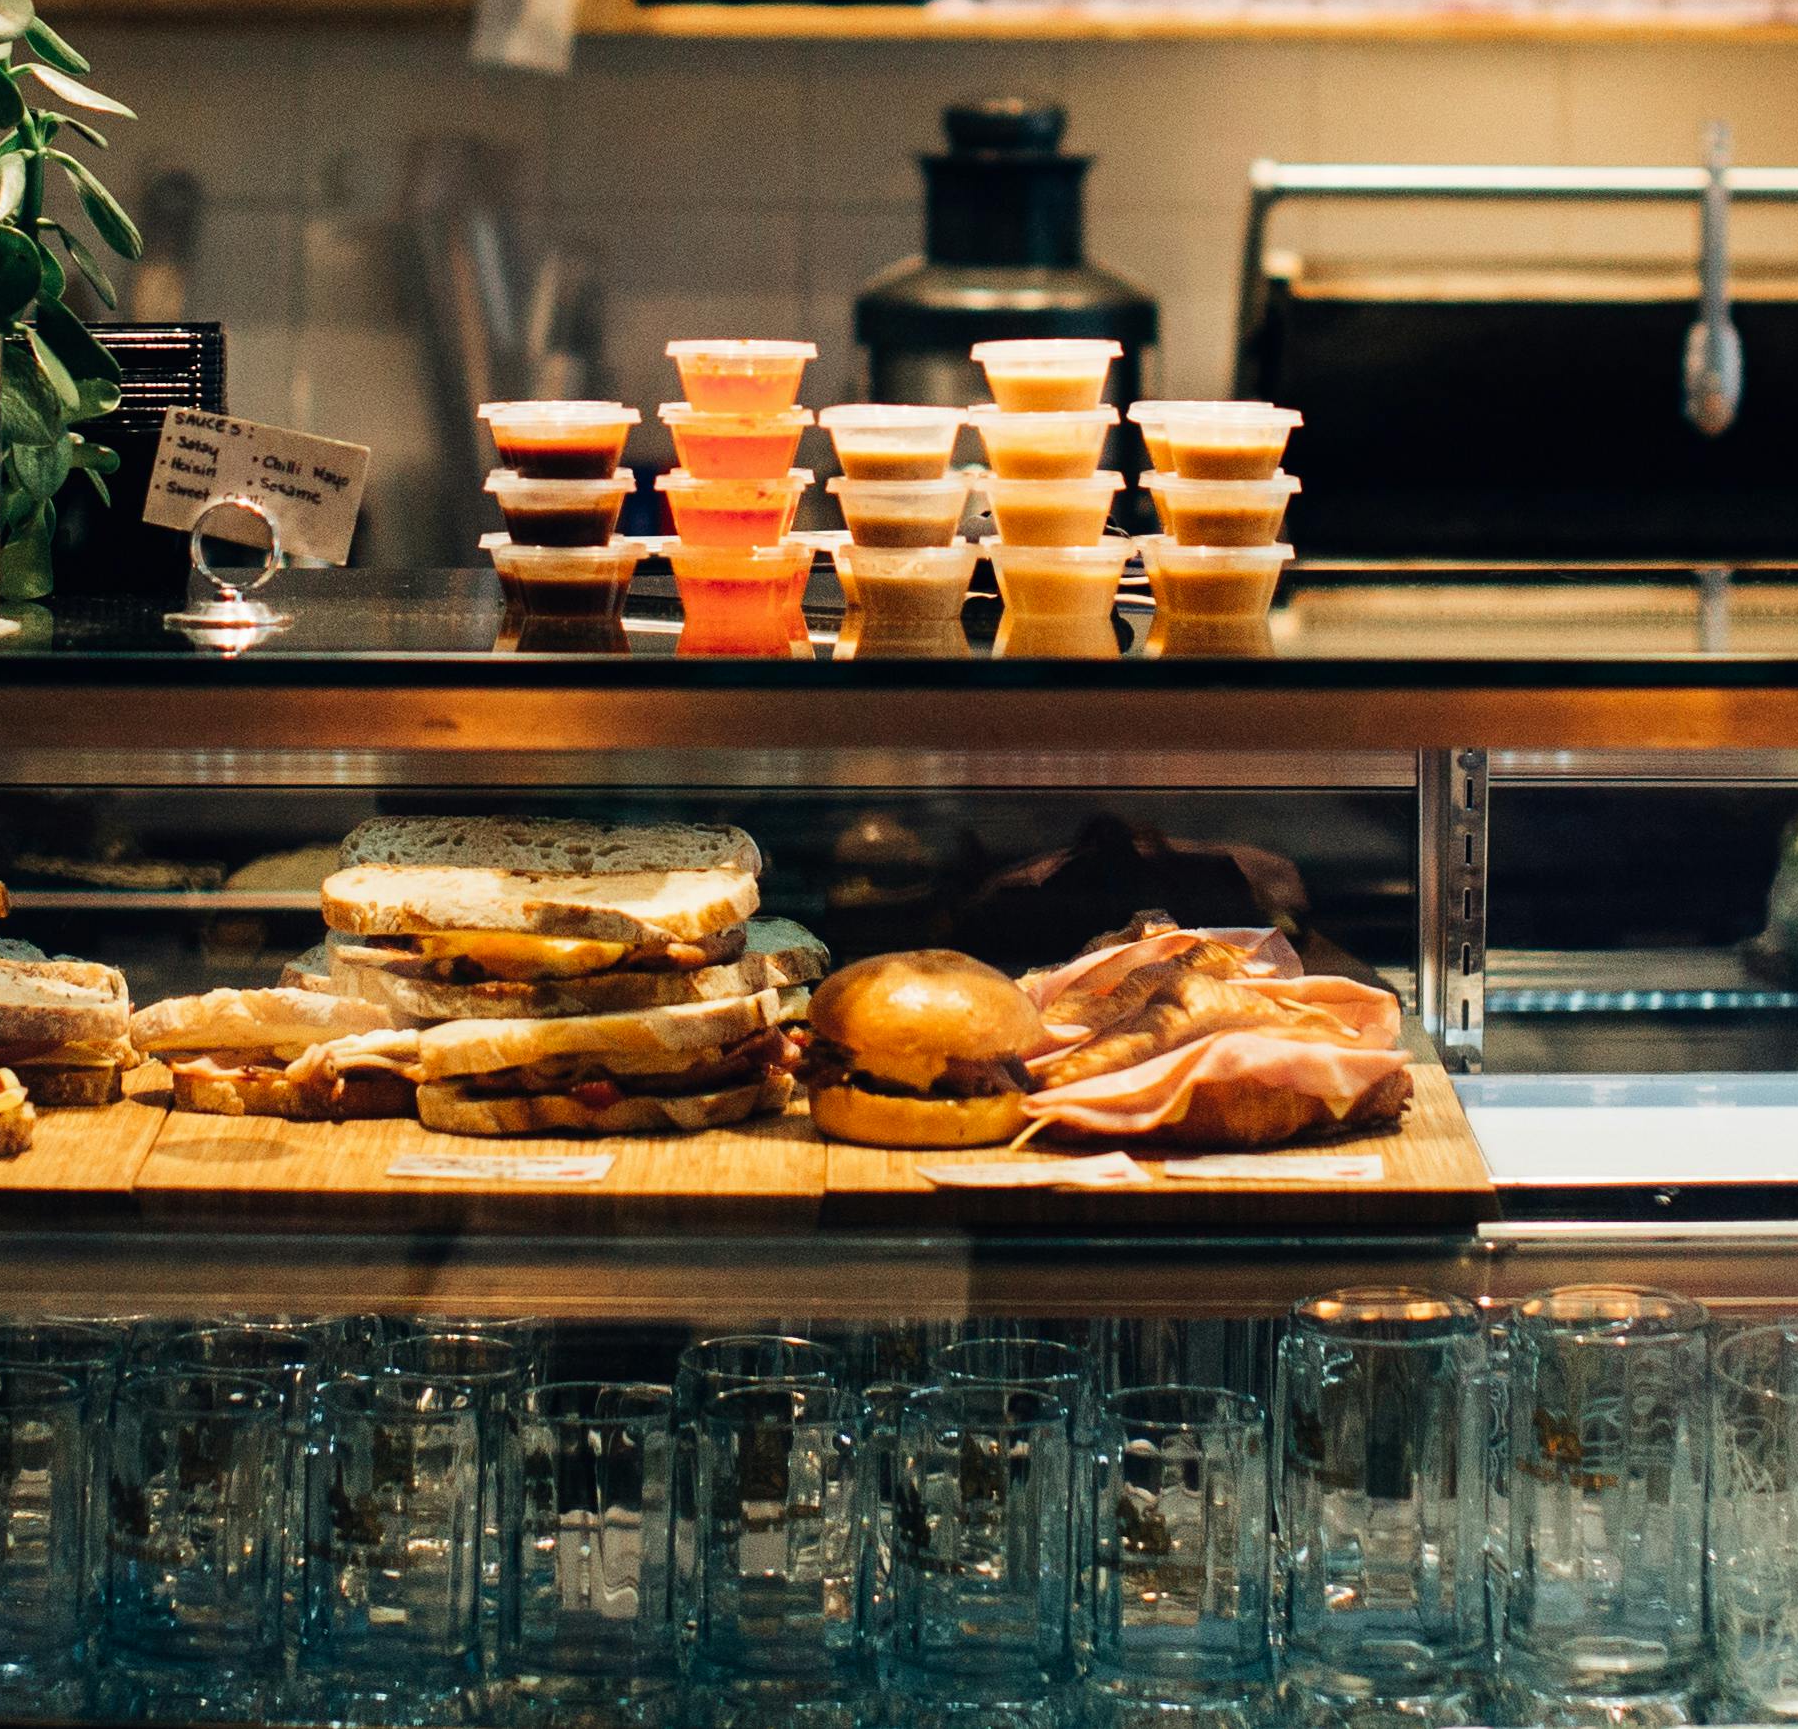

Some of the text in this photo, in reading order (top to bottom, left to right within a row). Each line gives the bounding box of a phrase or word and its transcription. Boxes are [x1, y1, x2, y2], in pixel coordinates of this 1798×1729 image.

[177, 436, 219, 463] Satay
[170, 457, 217, 478] Hoisin
[262, 454, 350, 492] Chilli Mayo
[166, 481, 211, 502] Sweet
[260, 477, 322, 505] Sesame
